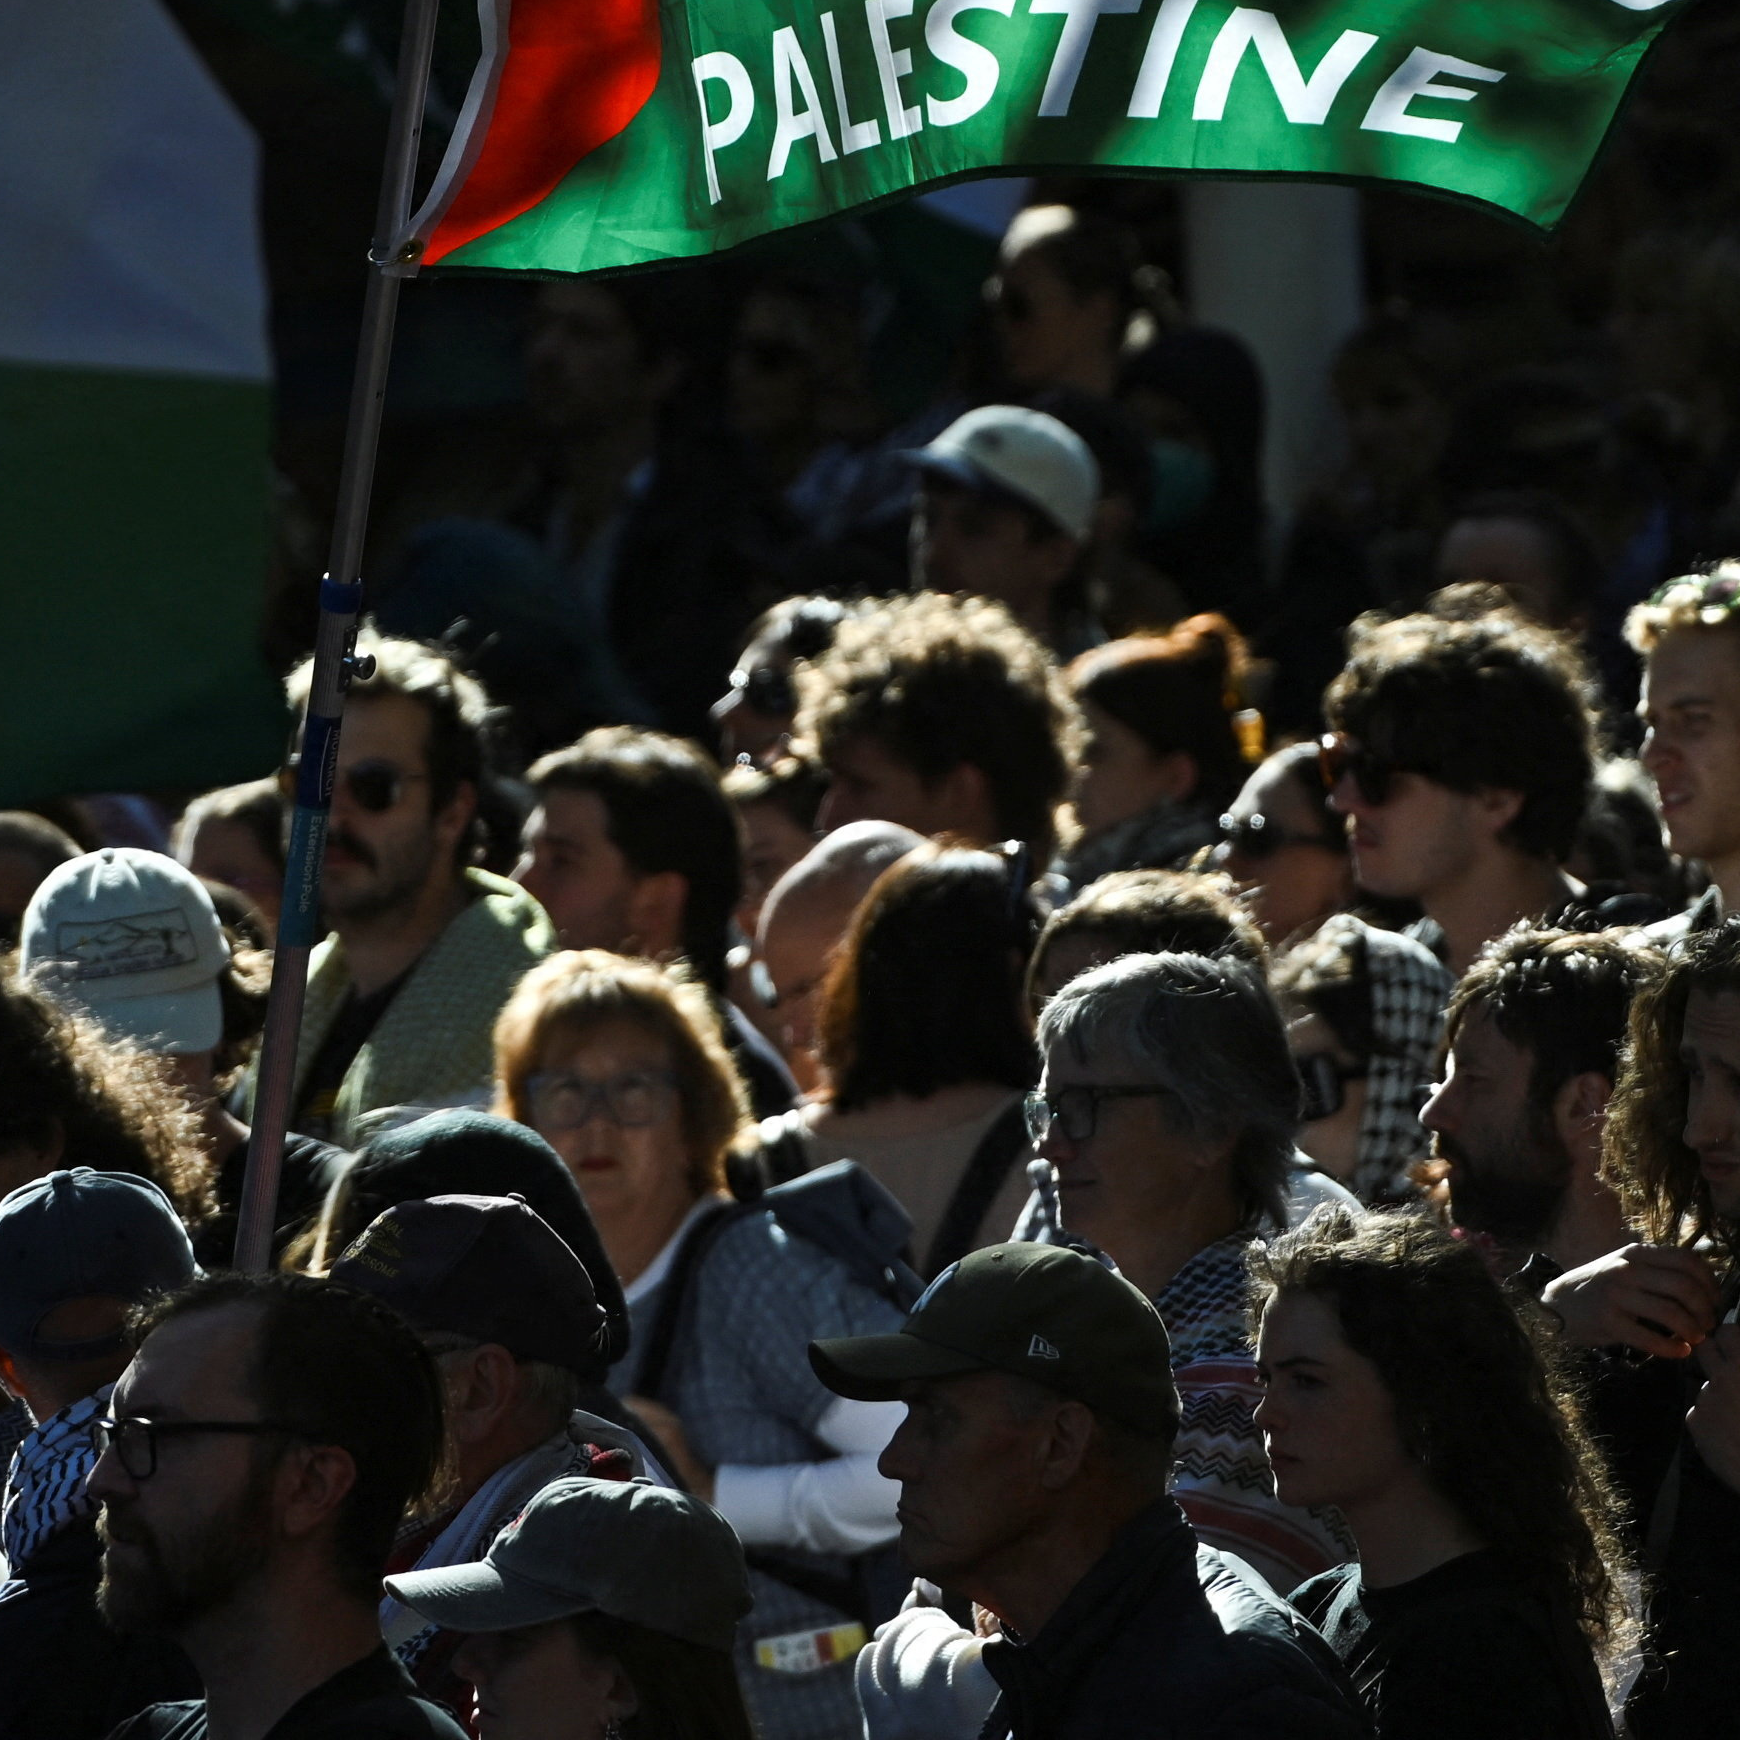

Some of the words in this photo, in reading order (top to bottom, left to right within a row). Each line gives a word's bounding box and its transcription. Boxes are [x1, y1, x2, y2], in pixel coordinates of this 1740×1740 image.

[323, 728, 341, 798] MONARCH
[302, 815, 323, 882] Extension
[297, 883, 314, 913] Pole
